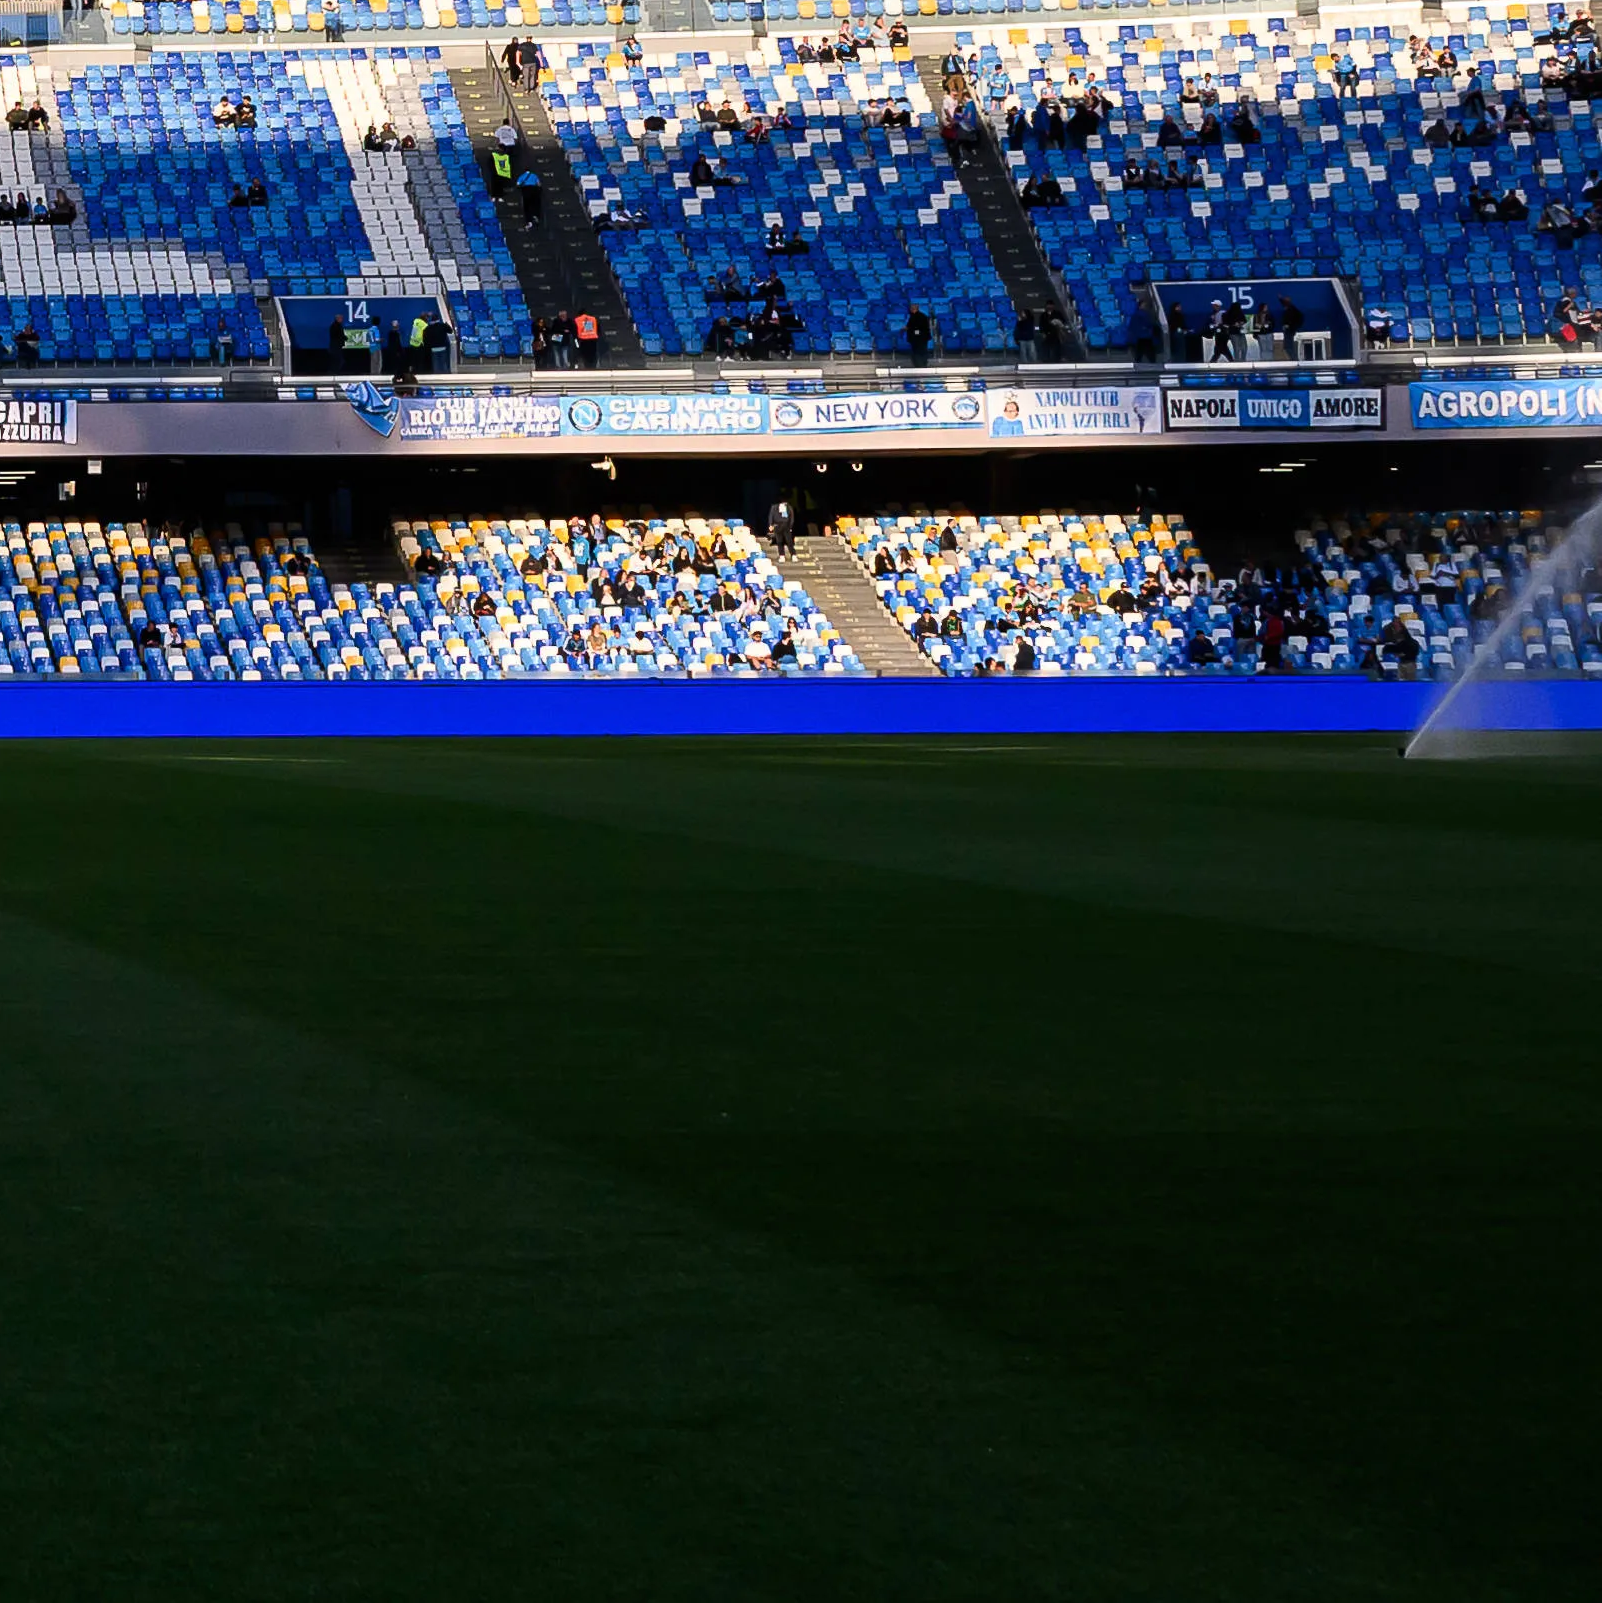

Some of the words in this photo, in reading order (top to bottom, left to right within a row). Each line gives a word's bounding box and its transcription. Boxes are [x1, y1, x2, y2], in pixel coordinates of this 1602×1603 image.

[1227, 286, 1254, 310] 15
[344, 300, 370, 323] 14
[608, 399, 671, 414] CLUB
[676, 396, 761, 412] NAPOLI
[1035, 392, 1081, 407] NAPOLI
[1085, 390, 1119, 407] CLUB
[1170, 398, 1238, 419] NAPOLI
[1246, 398, 1303, 419] UNICO
[1313, 397, 1379, 418] AMORE
[1418, 389, 1568, 419] AGROPOLI
[409, 409, 446, 426] RIO
[450, 408, 476, 425] DE
[608, 411, 762, 431] CARINARO
[815, 402, 869, 423] NEW
[875, 399, 939, 420] YORK
